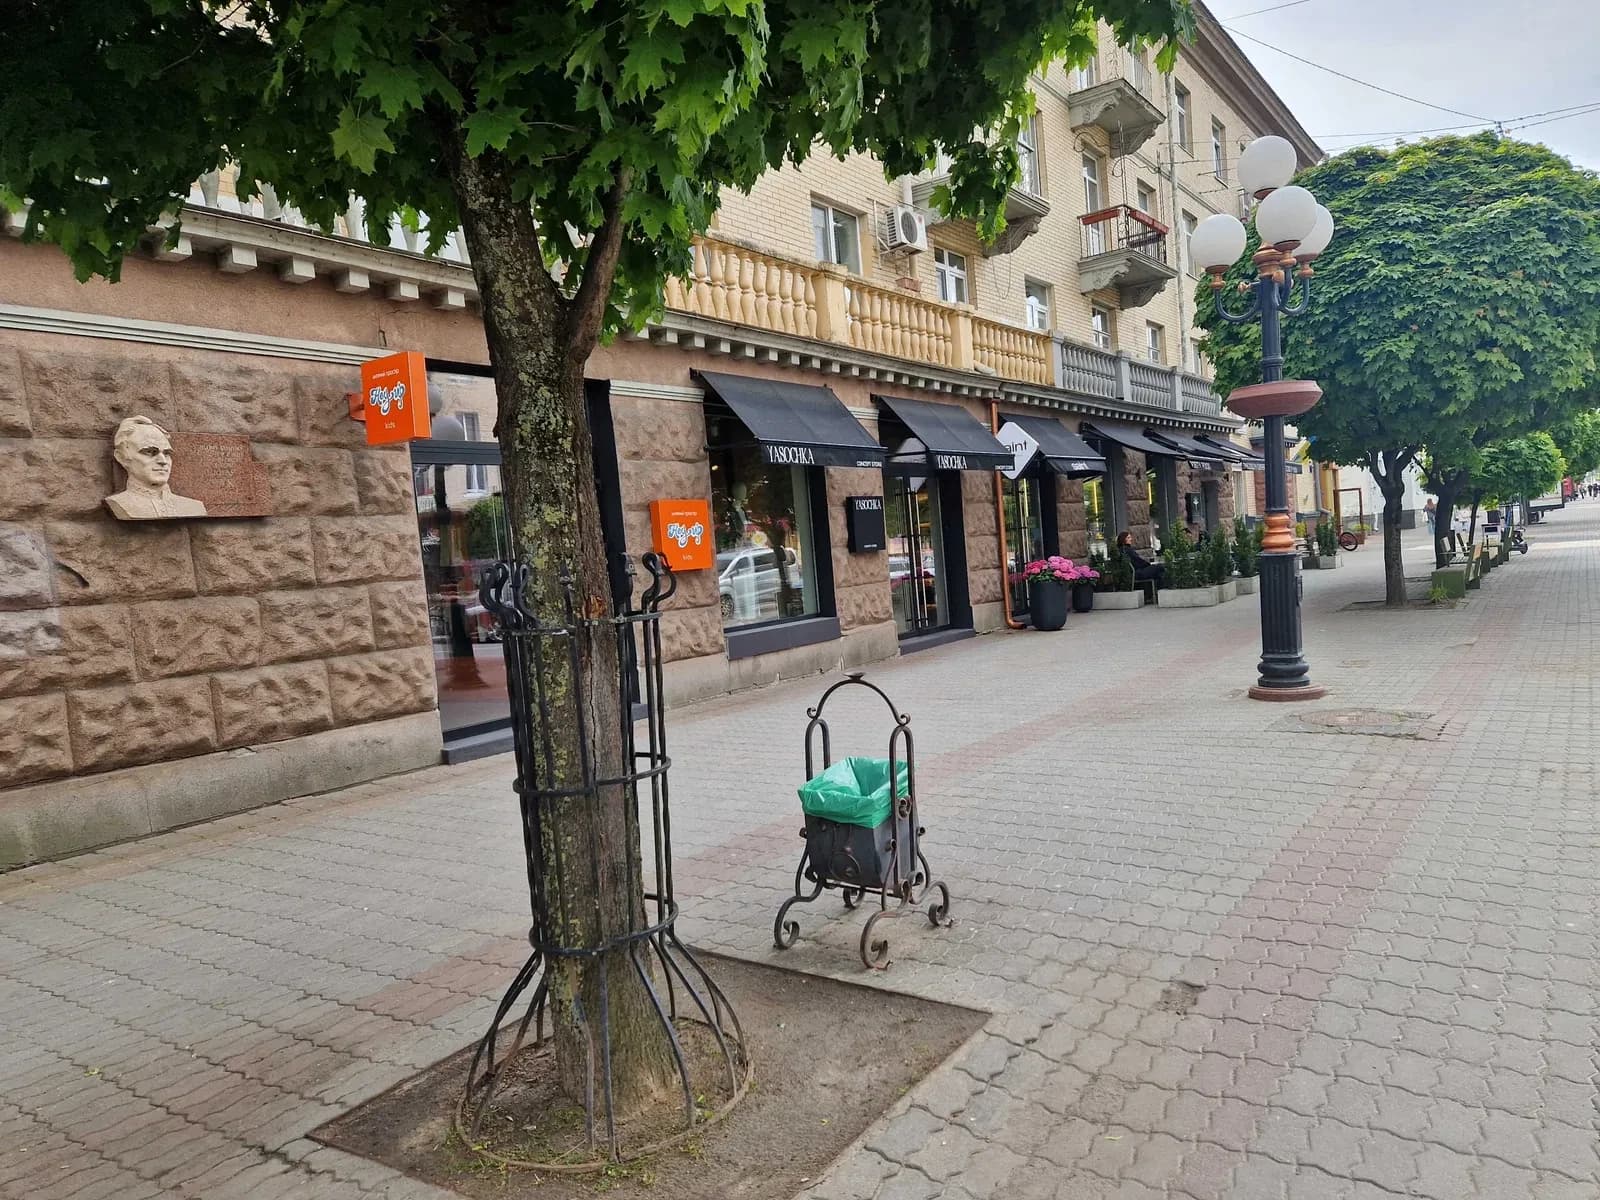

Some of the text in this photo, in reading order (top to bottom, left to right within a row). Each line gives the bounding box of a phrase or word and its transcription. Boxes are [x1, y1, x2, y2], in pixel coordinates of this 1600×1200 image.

[1003, 440, 1027, 453] aint
[766, 445, 815, 465] YASOCHKA
[936, 455, 968, 470] YASOCHKA
[855, 499, 882, 510] YASOCHKA
